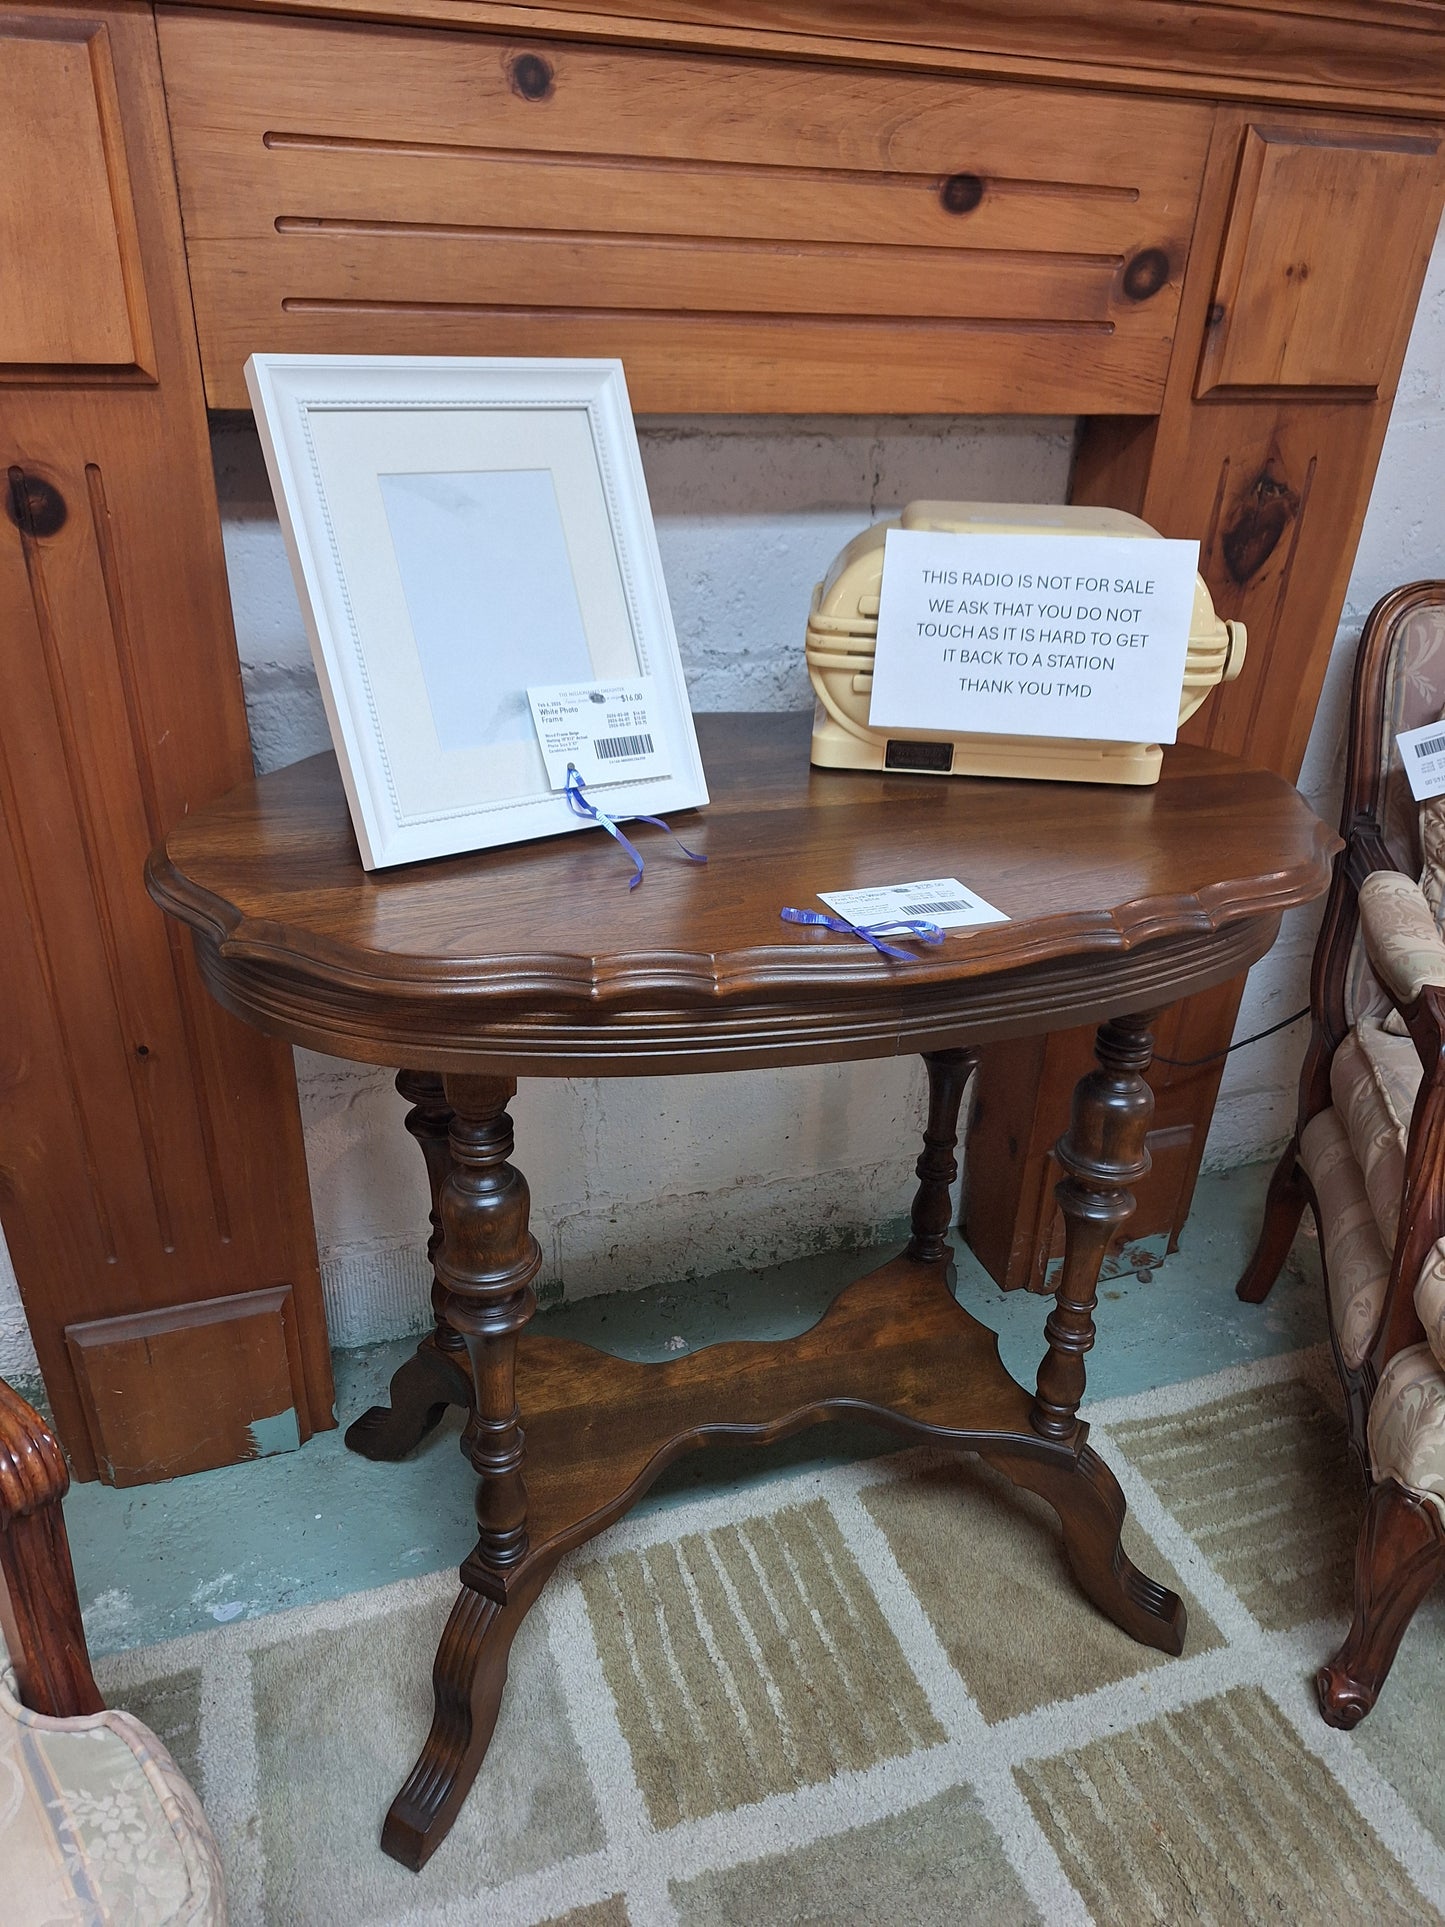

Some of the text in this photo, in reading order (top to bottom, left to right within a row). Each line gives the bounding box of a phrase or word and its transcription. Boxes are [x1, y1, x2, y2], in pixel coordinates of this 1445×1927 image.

[922, 570, 1155, 595] THIS RADIO IS NOT FOR SALE
[928, 599, 1142, 623] WE ASK THAT YOU DO NOT
[916, 622, 1150, 648] TOUCH AS IT IS HARD TO GET
[943, 648, 1115, 671] IT BACK TO A STATION
[621, 693, 643, 702] $16.00
[959, 677, 1092, 698] THANK YOU TMD
[539, 706, 578, 716] White Photo
